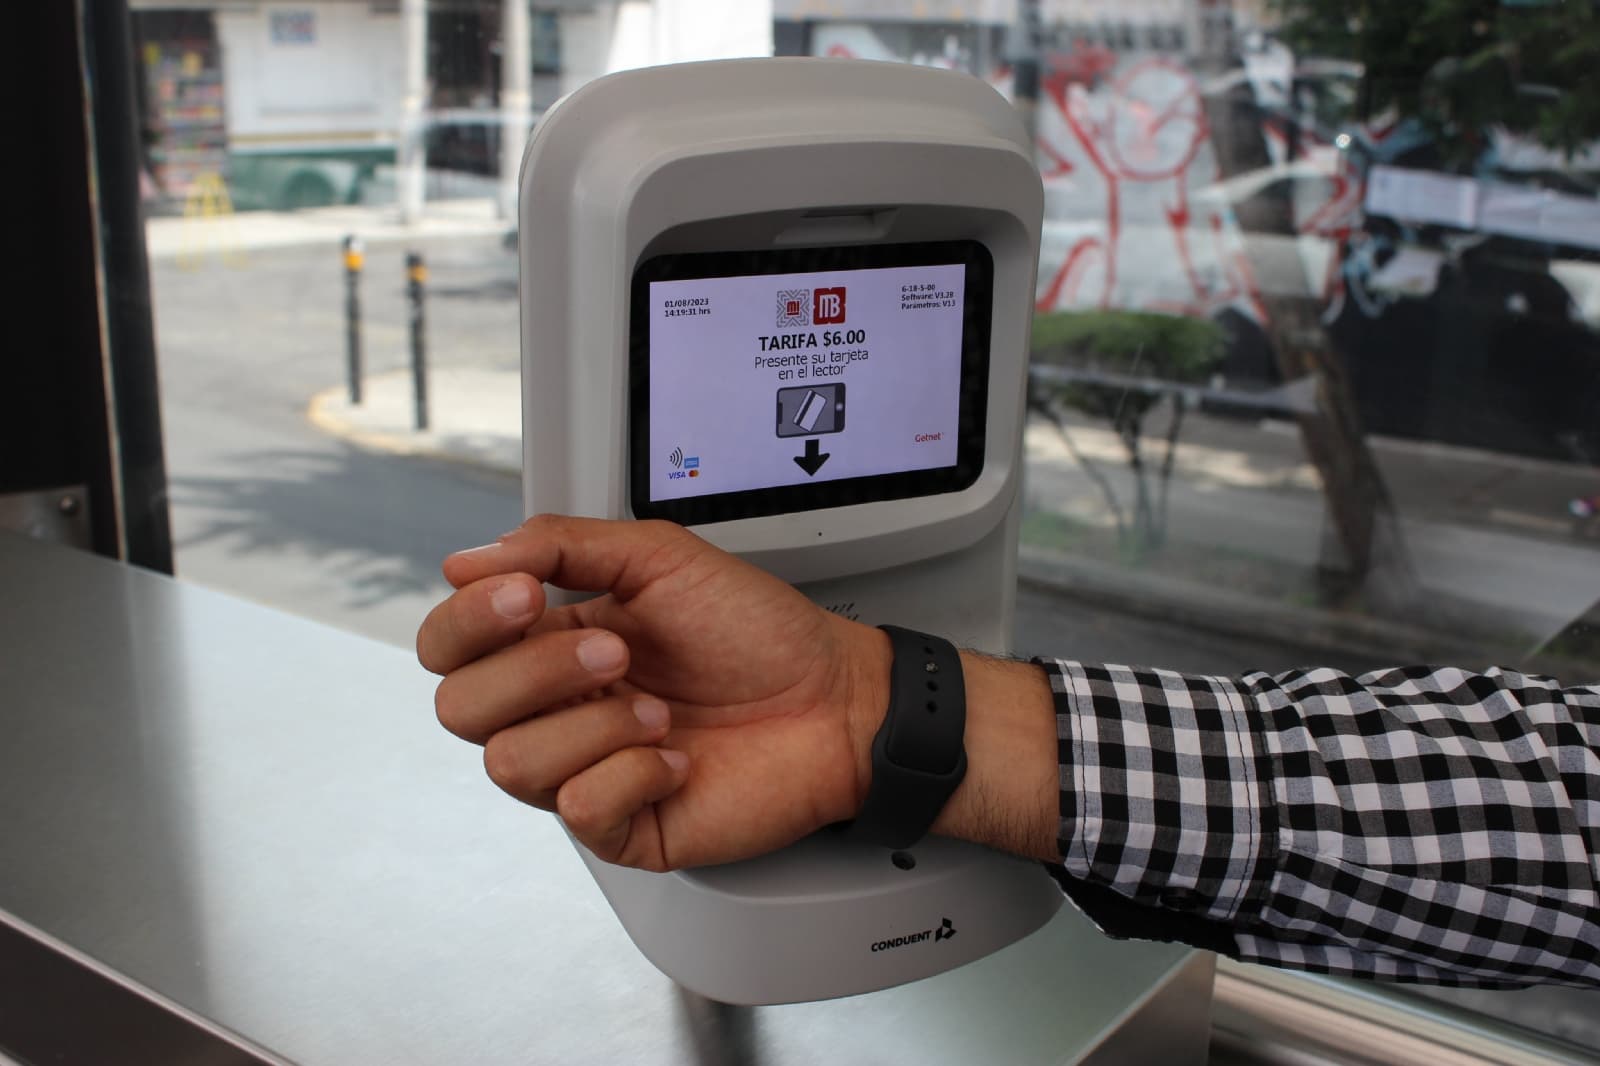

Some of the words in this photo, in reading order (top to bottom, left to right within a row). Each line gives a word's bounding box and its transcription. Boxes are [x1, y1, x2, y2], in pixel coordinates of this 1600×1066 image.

[664, 298, 709, 308] 01/08/2023
[901, 293, 933, 302] Software:
[664, 308, 696, 317] 14:19:31
[698, 307, 711, 315] hrs
[819, 294, 841, 318] MB
[758, 333, 818, 352] TARIFA
[823, 329, 866, 348] $6.00
[754, 354, 808, 369] Presente
[811, 353, 826, 364] su
[830, 348, 869, 364] tarjeta
[778, 369, 793, 380] en
[797, 365, 808, 379] el
[812, 364, 846, 377] lector
[914, 432, 942, 442] Getnet
[668, 471, 686, 479] VISA
[871, 929, 932, 952] CONDUENT
